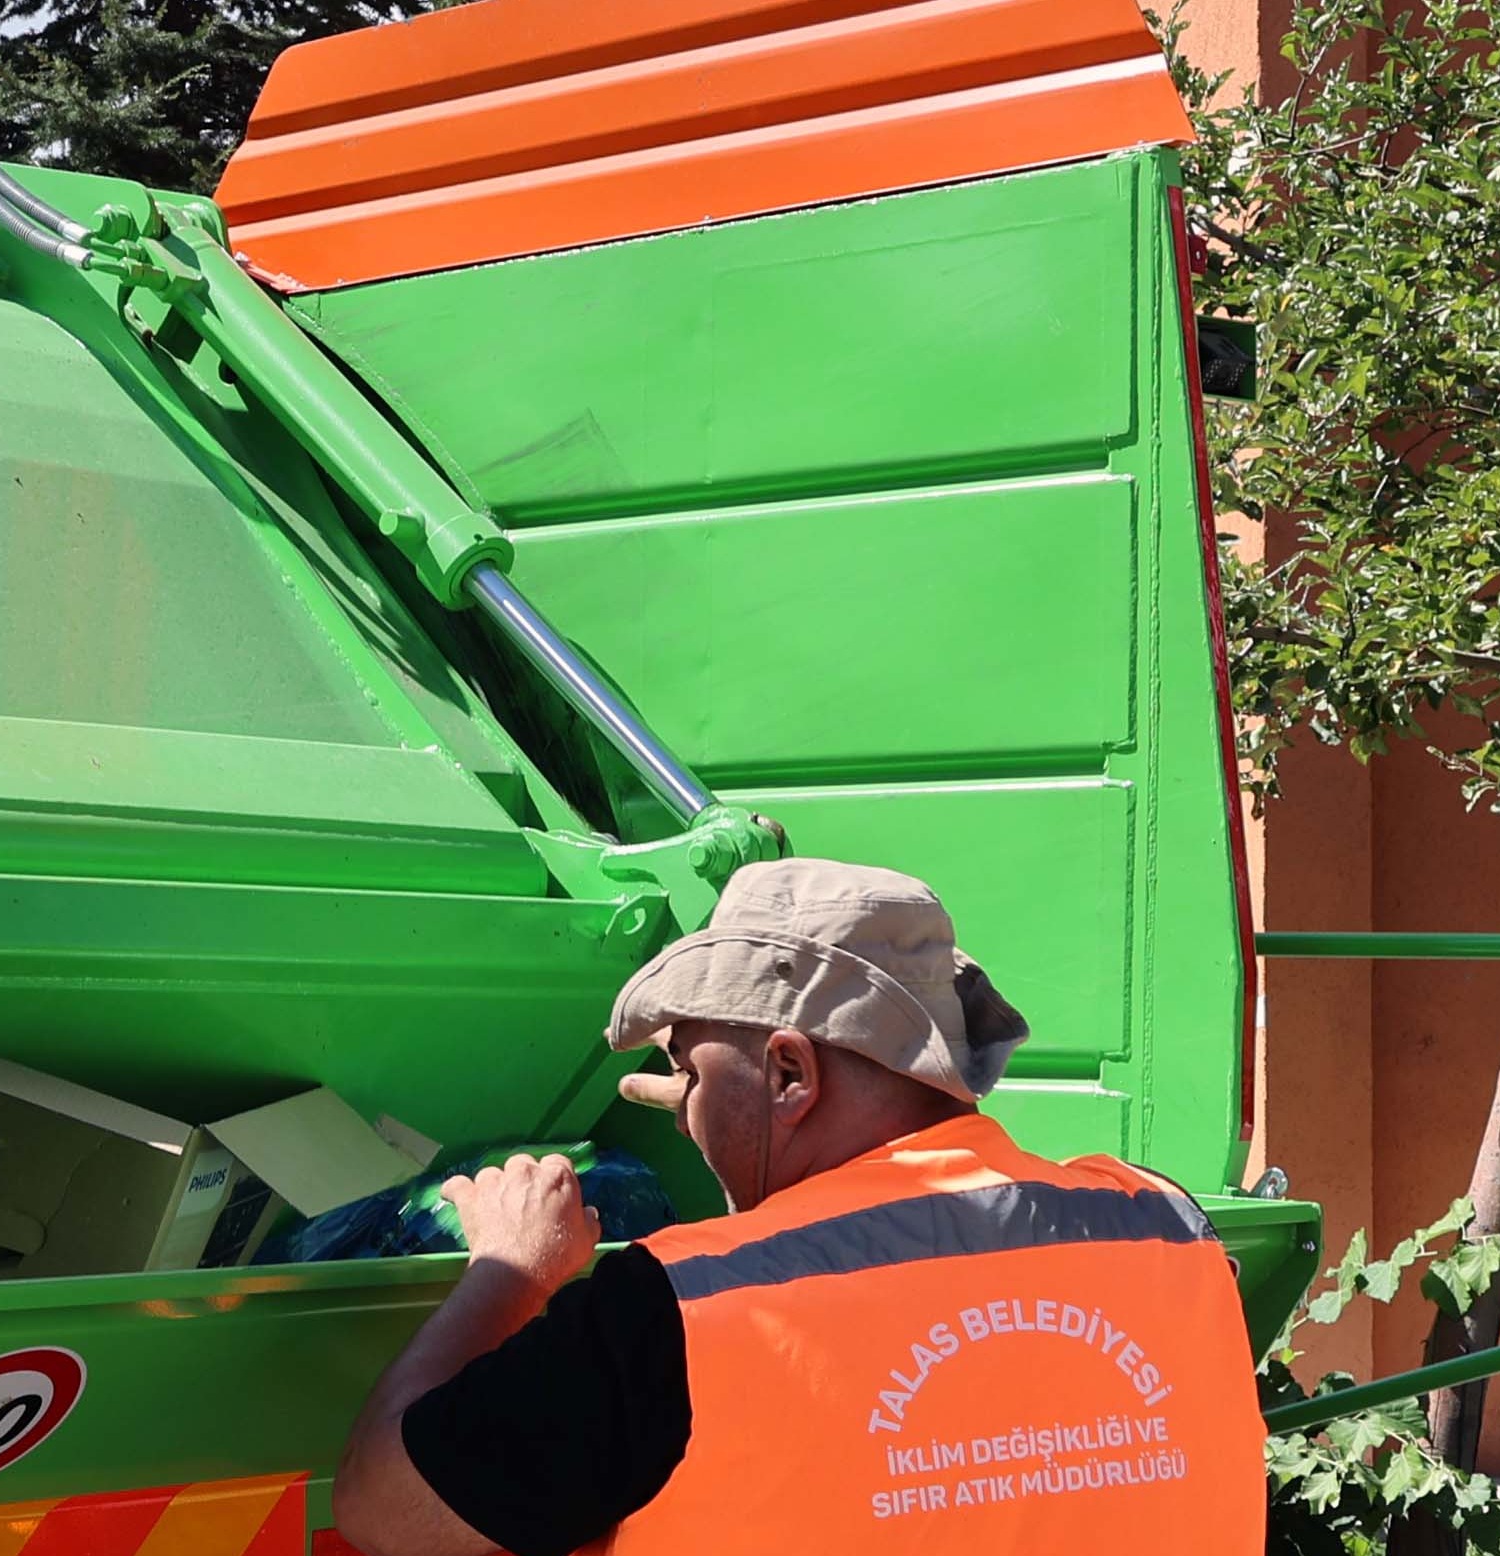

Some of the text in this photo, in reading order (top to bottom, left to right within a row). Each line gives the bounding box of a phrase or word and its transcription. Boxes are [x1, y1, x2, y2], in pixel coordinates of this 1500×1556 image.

[188, 1168, 228, 1193] PHILIPS
[868, 1299, 1174, 1434] TALAS BELEDİYESİ
[886, 1415, 1170, 1476] İKLİM DEĞİŞİKLİĞİ VE
[872, 1450, 1187, 1519] SIFIR ATIK MÜDÜRLÜĞÜ
